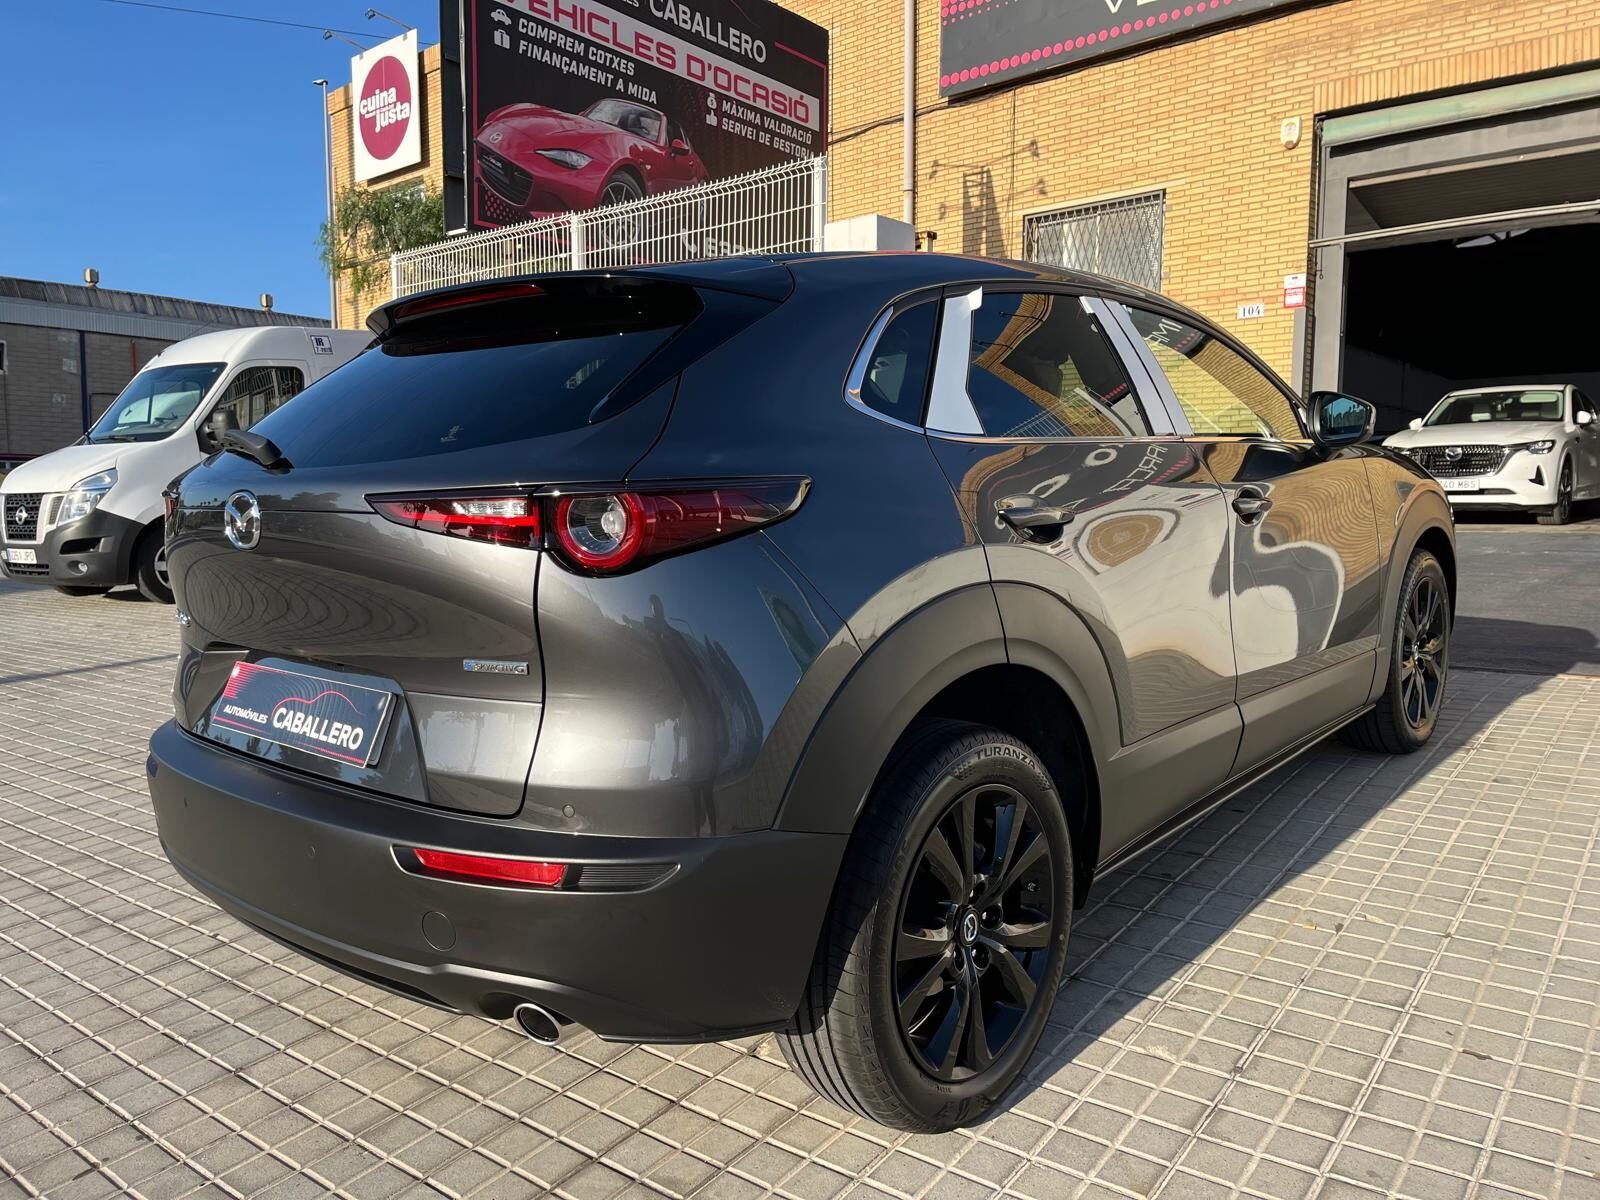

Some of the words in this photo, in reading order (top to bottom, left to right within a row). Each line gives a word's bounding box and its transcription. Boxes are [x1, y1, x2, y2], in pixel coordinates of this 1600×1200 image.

[518, 18, 584, 57] COMPREM
[588, 46, 635, 76] COTXES
[650, 0, 767, 63] CABALLERO
[501, 0, 677, 70] EHICLES
[687, 52, 809, 125] D'OCASIÓ
[518, 40, 614, 88] FINANÇAMENT
[616, 78, 625, 93] A
[627, 82, 657, 105] MIDA
[360, 87, 397, 115] cuina
[375, 101, 410, 134] justa
[722, 100, 761, 126] MÀXIMA
[764, 116, 812, 145] VALORACIÓ
[722, 118, 756, 141] SERVEI
[758, 131, 771, 147] DE
[1242, 305, 1261, 317] 104
[223, 704, 269, 724] AUTOMÓVILES
[272, 707, 364, 750] CABALLERO
[975, 746, 1037, 770] TURANZA
